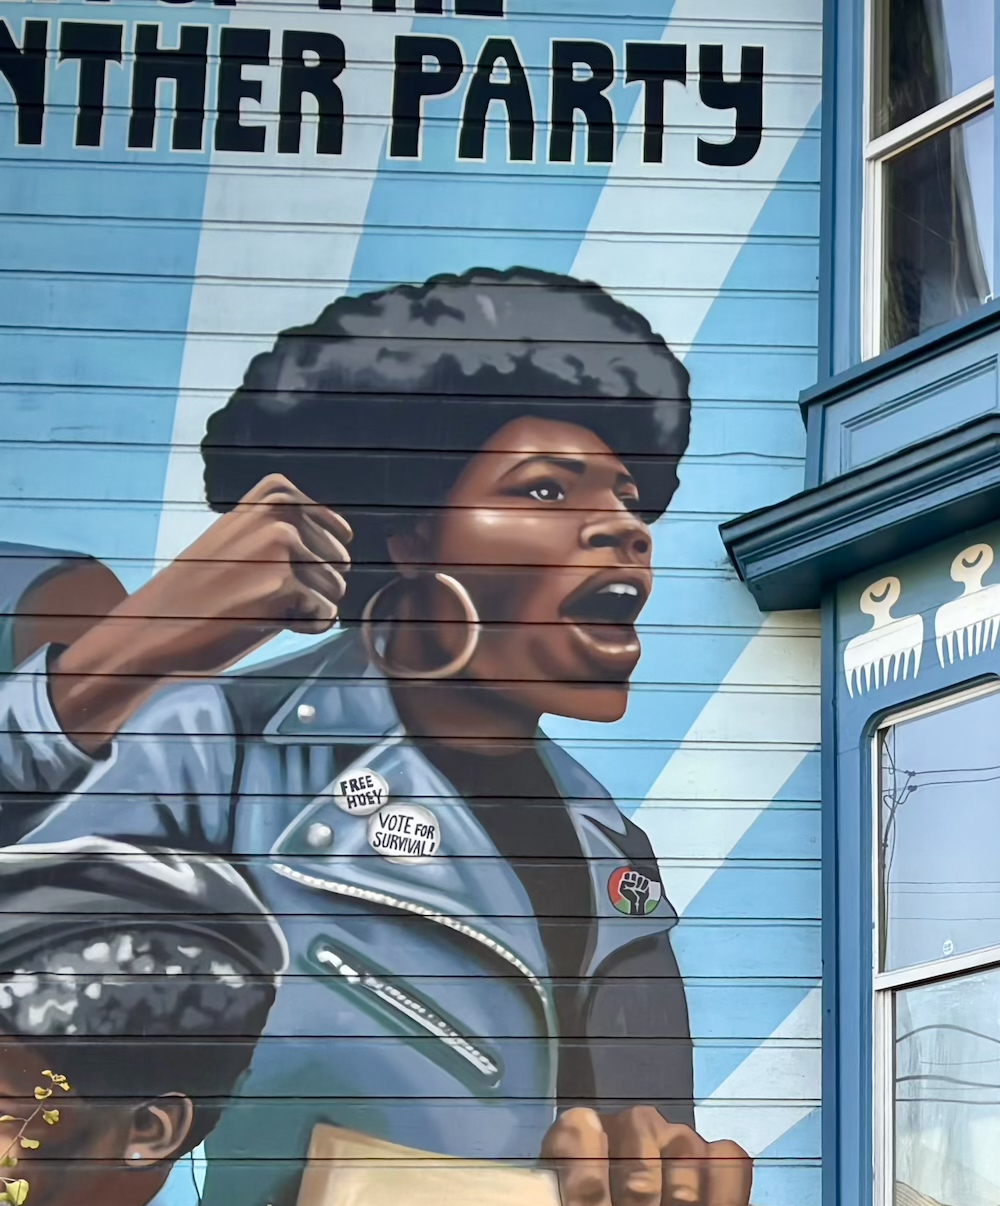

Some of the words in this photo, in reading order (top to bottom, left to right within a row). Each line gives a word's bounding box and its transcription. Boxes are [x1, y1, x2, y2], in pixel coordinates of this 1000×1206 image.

[390, 35, 764, 166] PARTY
[340, 775, 374, 796] FREE
[347, 788, 383, 809] HUEY
[379, 812, 414, 836] VOTE
[415, 822, 436, 838] FOR
[373, 831, 436, 857] SURVIVAL!
